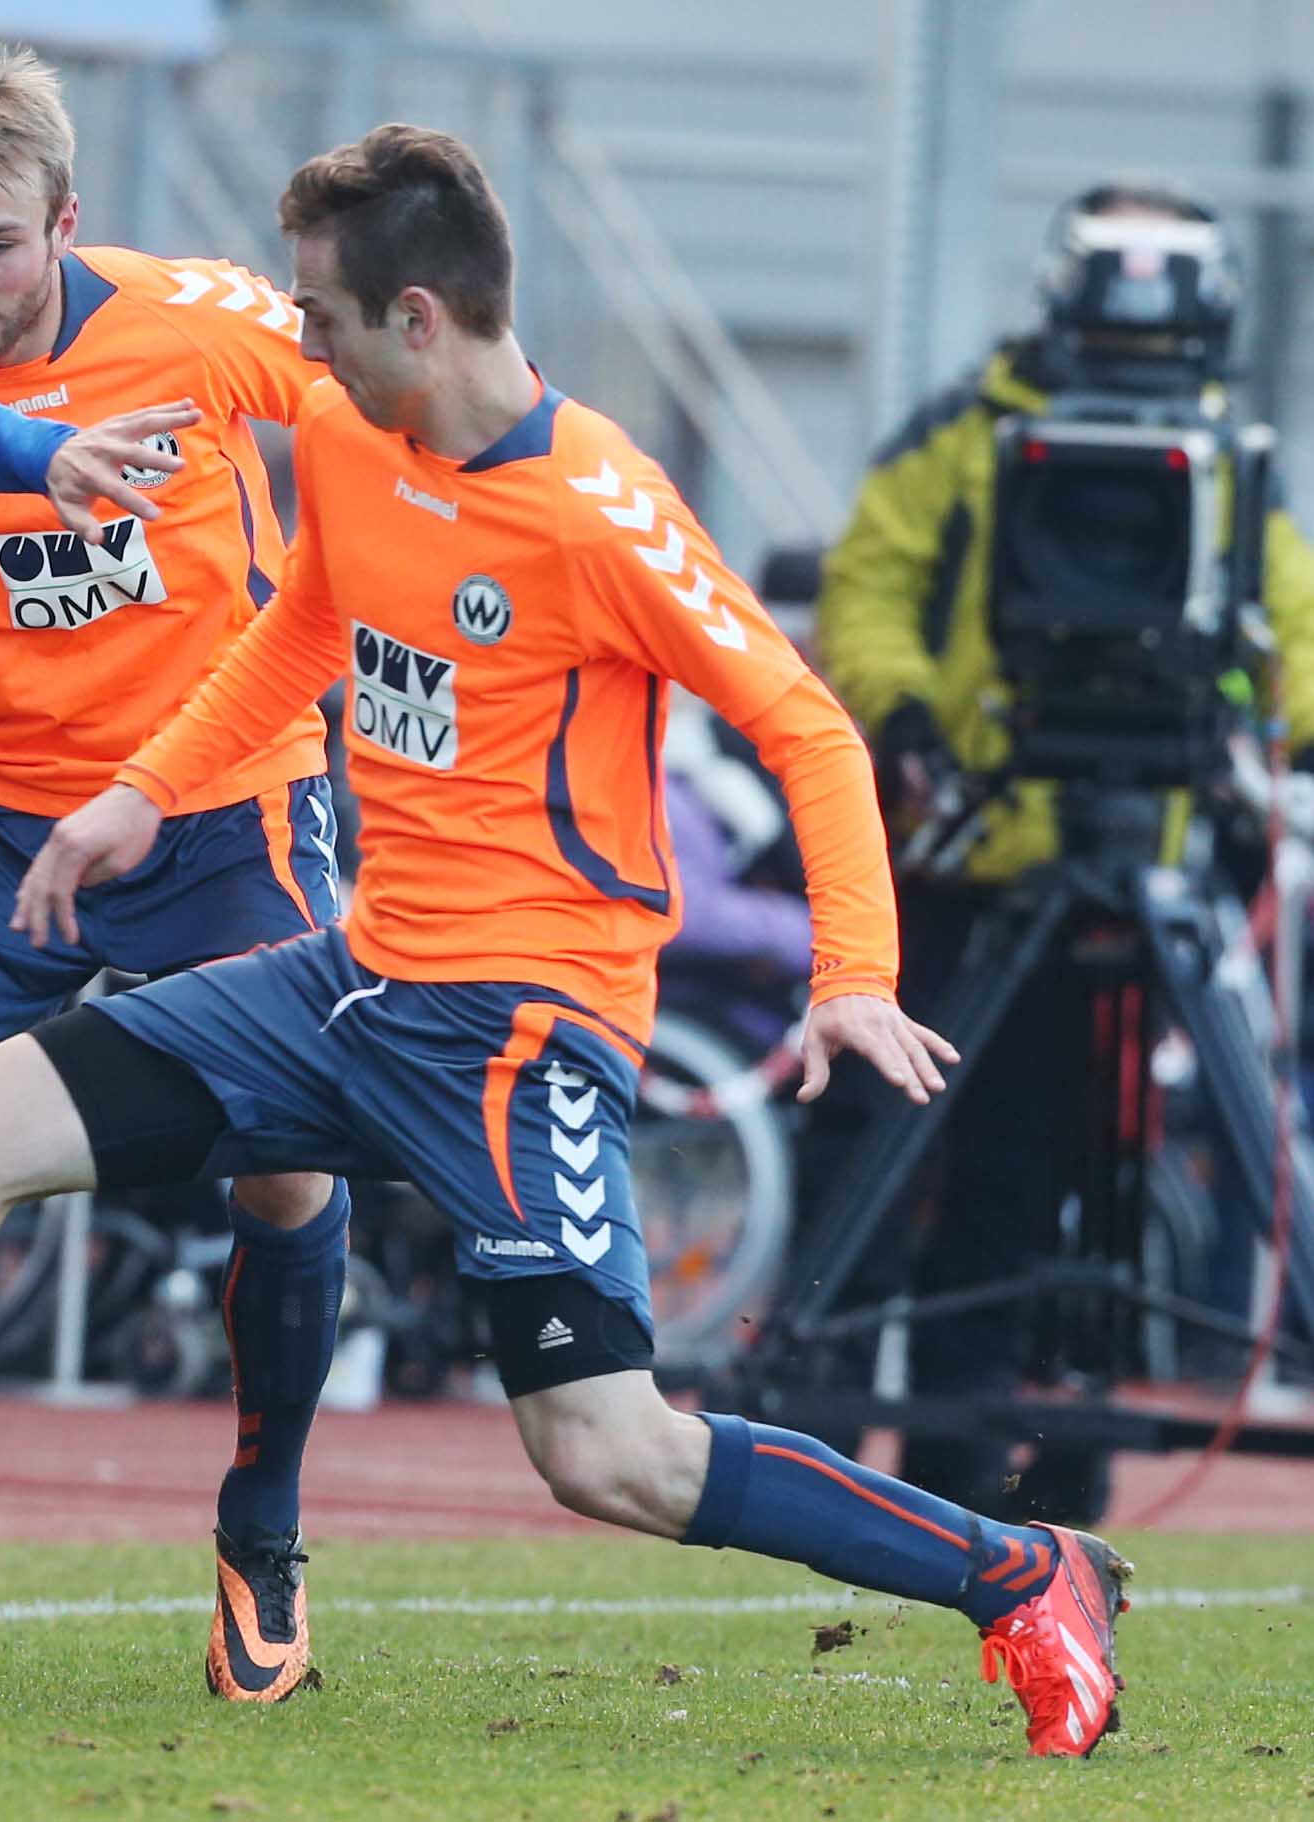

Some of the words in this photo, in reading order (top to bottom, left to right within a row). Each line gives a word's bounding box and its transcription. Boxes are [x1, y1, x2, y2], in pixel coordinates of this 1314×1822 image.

[8, 383, 69, 413] mmel
[14, 569, 148, 629] OMV
[355, 691, 450, 762] OMV
